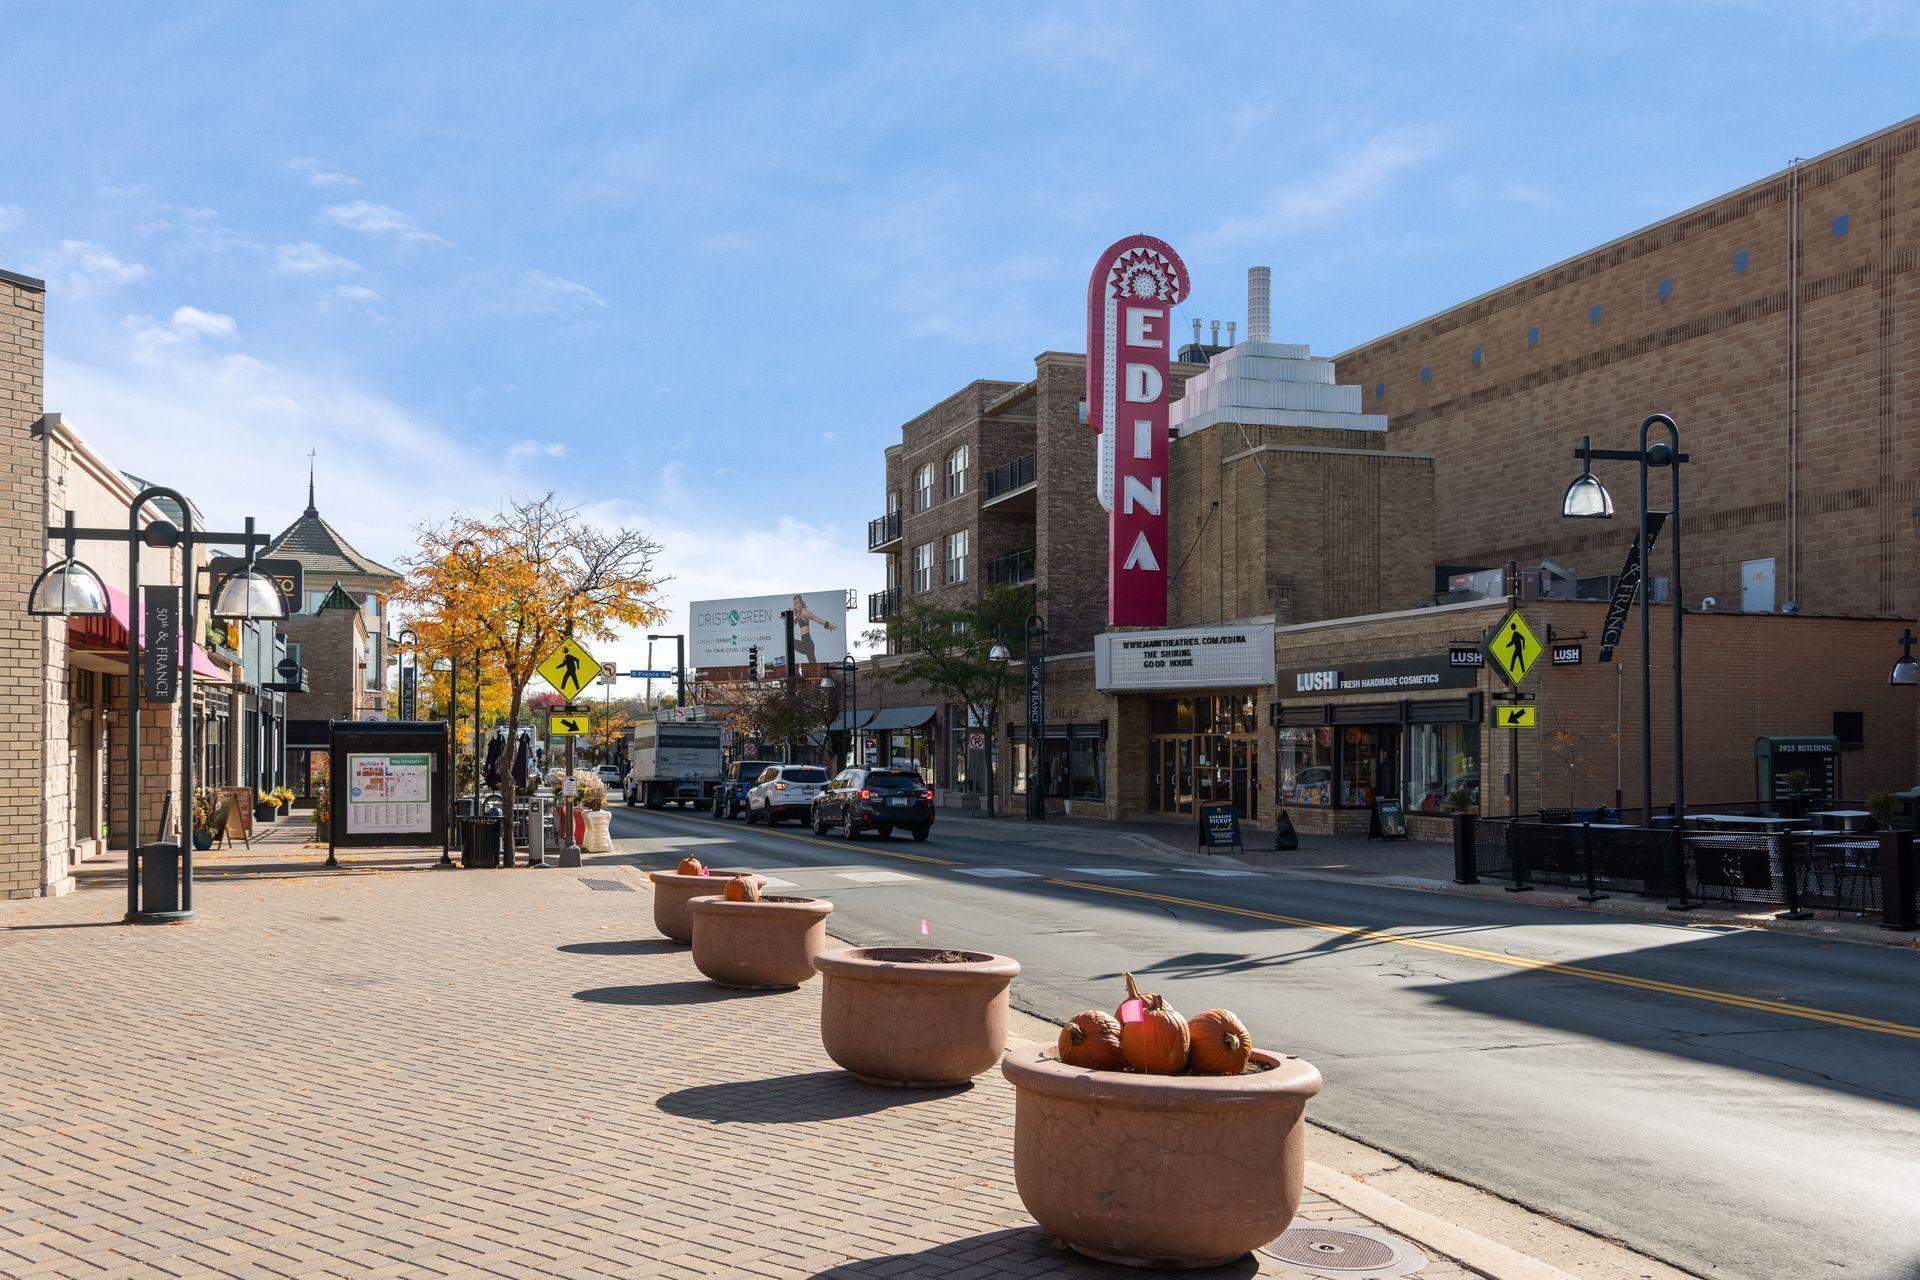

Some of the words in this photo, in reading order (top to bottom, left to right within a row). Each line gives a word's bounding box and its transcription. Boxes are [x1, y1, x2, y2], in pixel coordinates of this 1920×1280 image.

[1124, 306, 1163, 571] EDINA
[155, 631, 169, 645] &
[1143, 650, 1158, 659] THE
[1160, 649, 1192, 658] SHINING
[1451, 652, 1483, 663] LUSH
[1553, 649, 1580, 661] LUSH
[1143, 660, 1166, 668] GOOD
[1169, 659, 1194, 668] HOUSE
[156, 647, 168, 697] FRANCE
[1296, 671, 1335, 692] LUSH
[1340, 679, 1361, 689] FRESH
[1361, 677, 1398, 688] HANDMADE
[1399, 674, 1439, 685] COSMETICS
[1031, 690, 1039, 724] FRANCE
[1797, 744, 1833, 752] BUILDING
